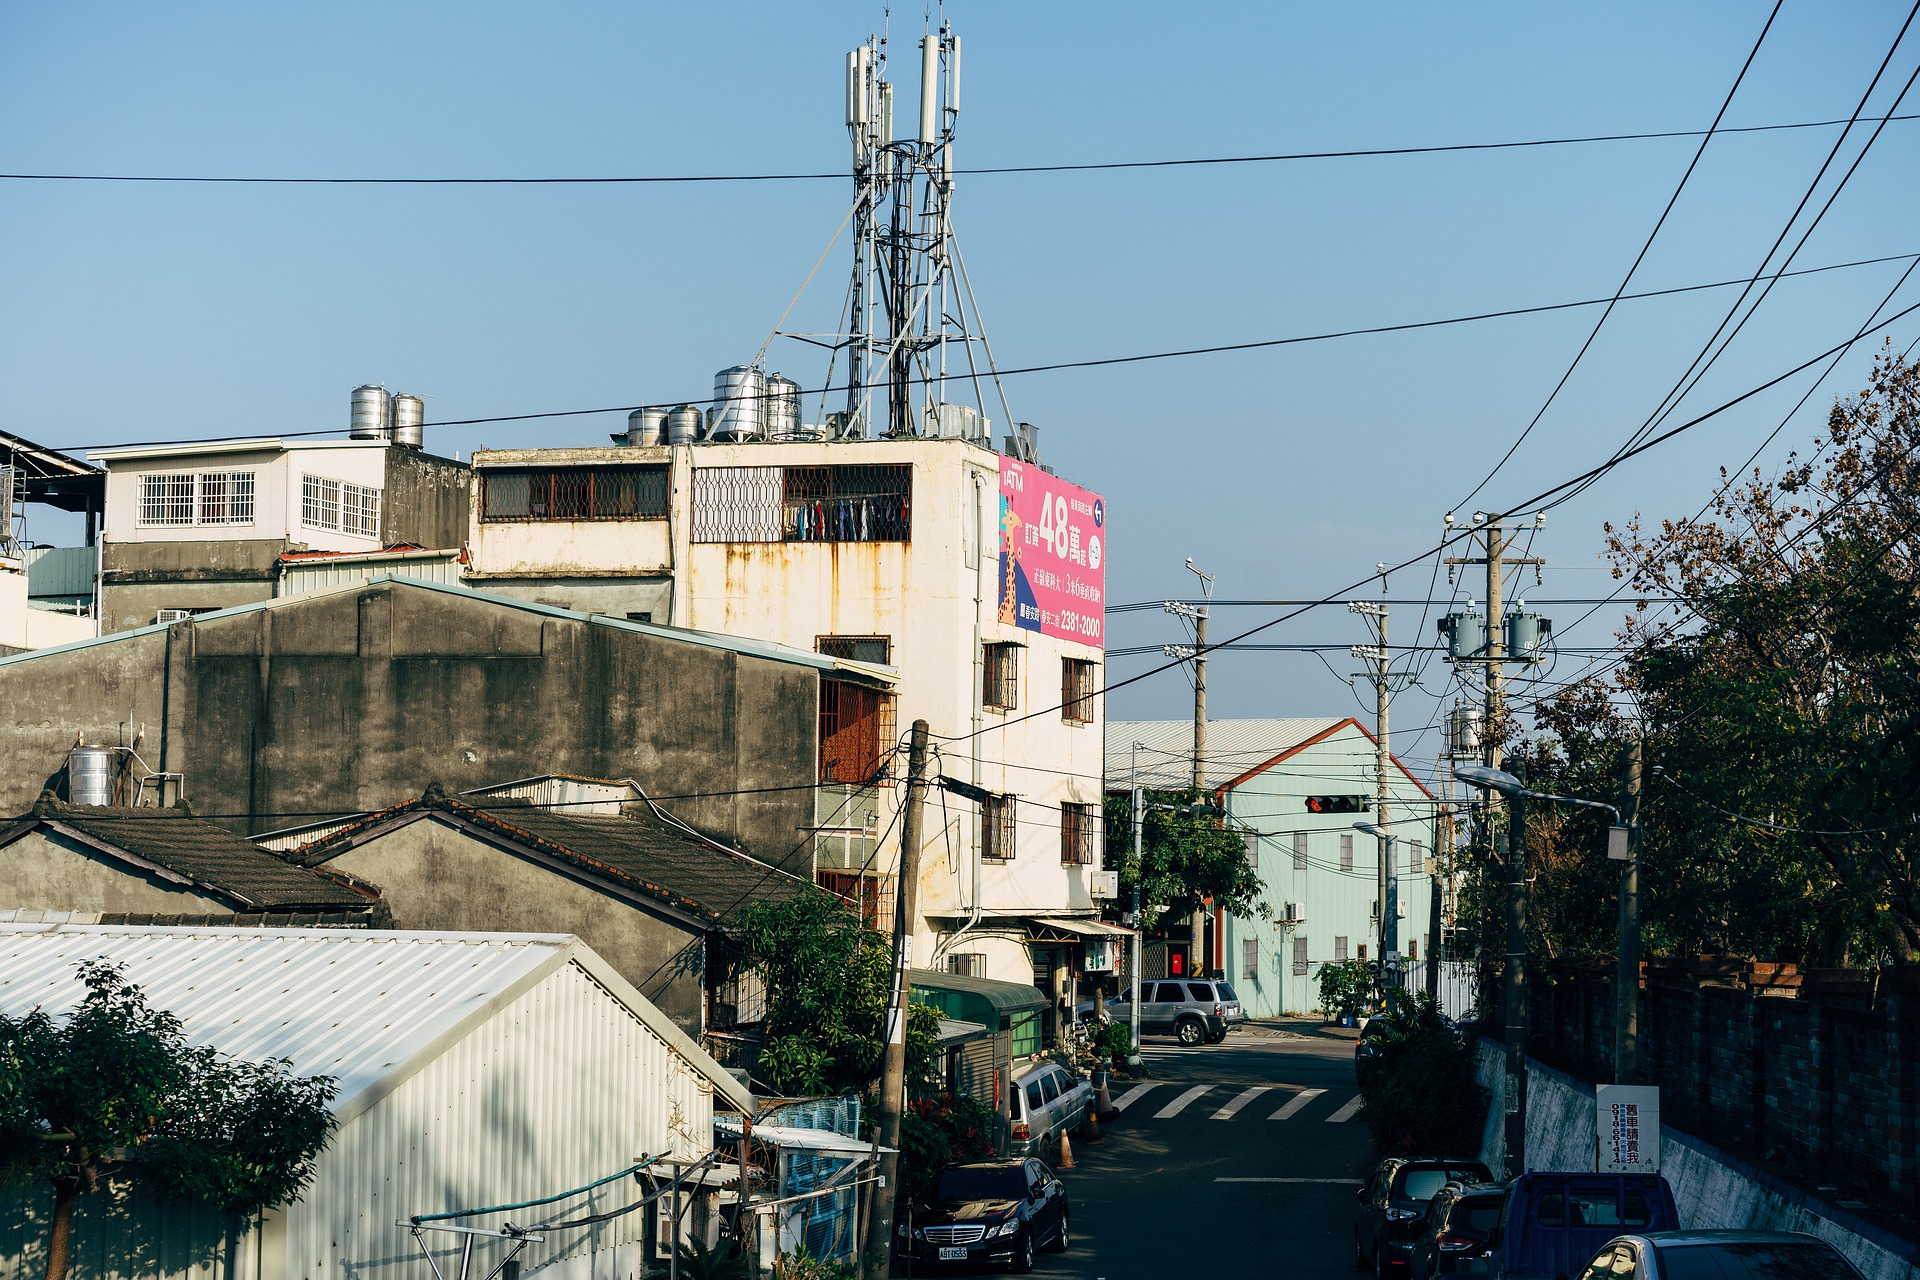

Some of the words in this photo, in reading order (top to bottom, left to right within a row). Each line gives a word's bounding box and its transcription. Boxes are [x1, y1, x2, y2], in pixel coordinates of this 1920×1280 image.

[1061, 609, 1100, 638] 2381-2000
[1626, 1104, 1639, 1164] 舊車請賣我
